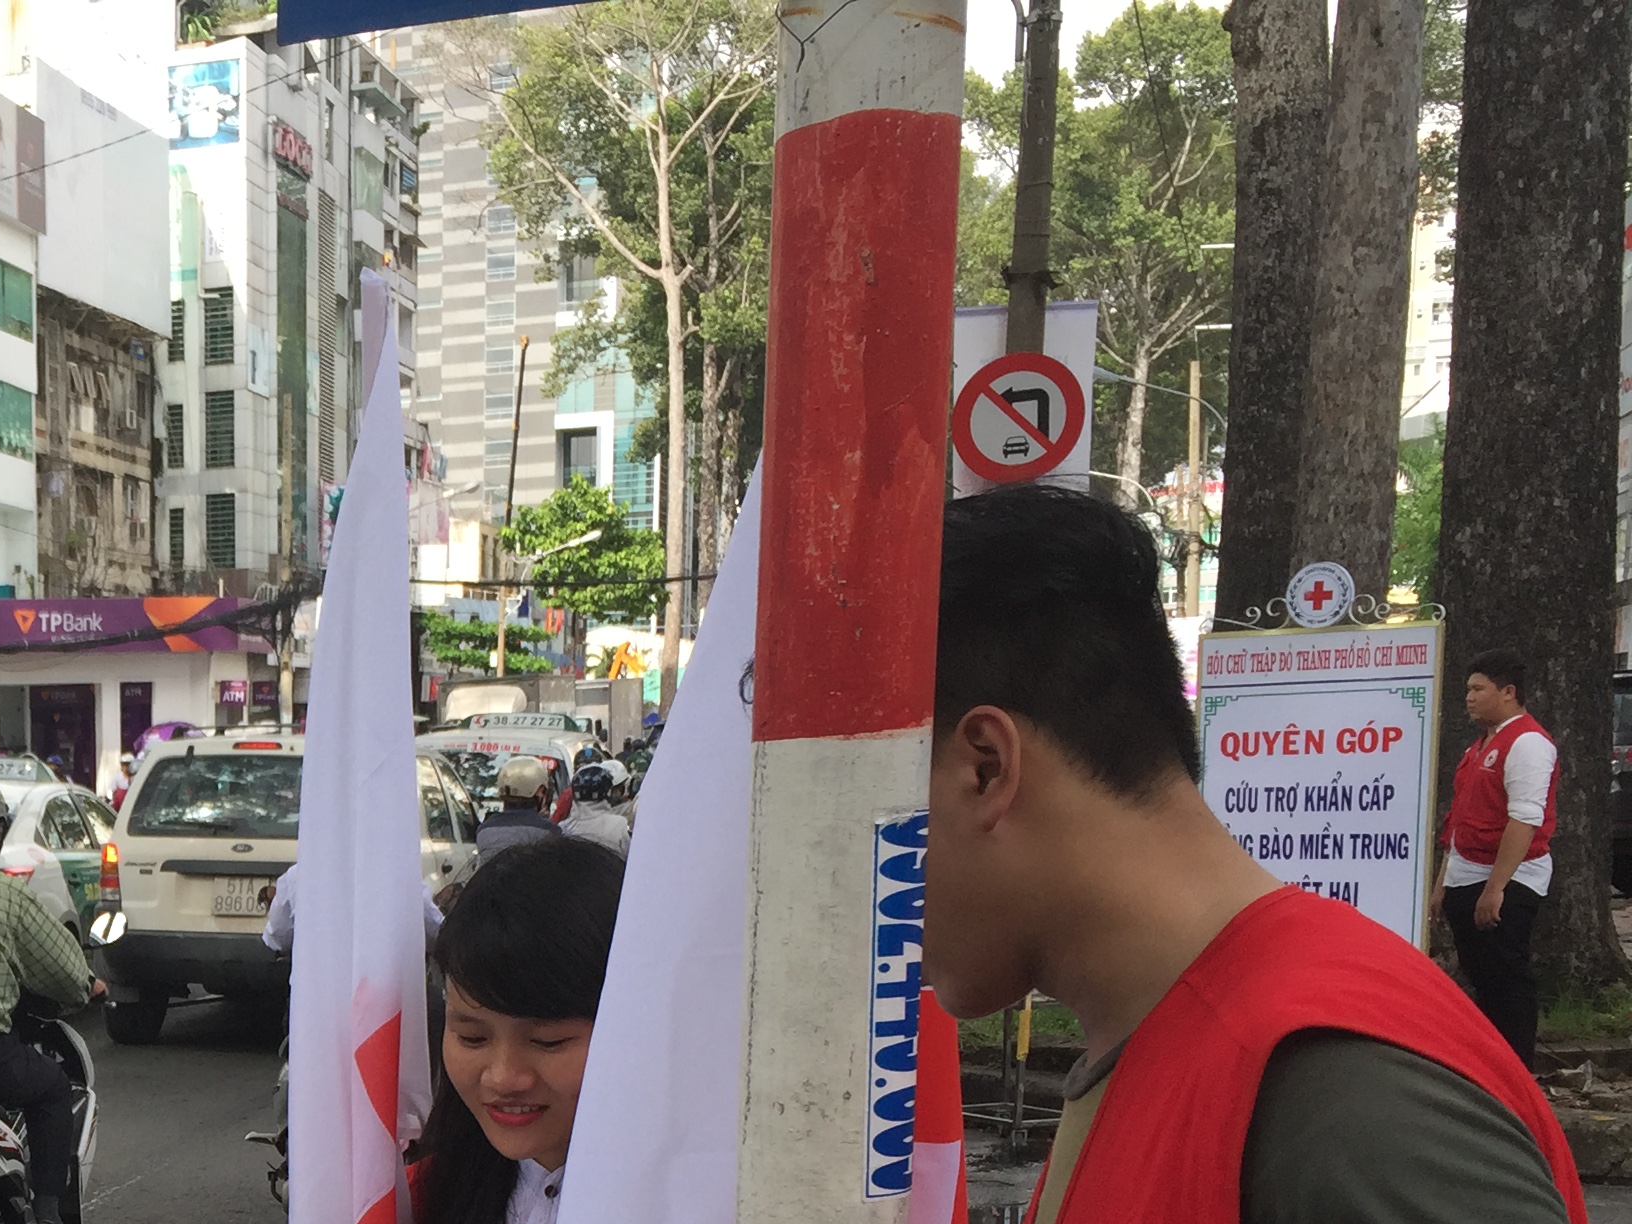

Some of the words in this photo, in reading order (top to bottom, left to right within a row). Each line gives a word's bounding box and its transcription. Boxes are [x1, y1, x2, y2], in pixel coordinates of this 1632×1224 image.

[38, 611, 103, 633] TPBank
[1250, 646, 1277, 677] THẬP
[1296, 643, 1331, 671] THÀNH
[1334, 639, 1356, 669] PHỐ
[1374, 640, 1394, 667] CHÍ
[222, 690, 245, 703] ATM
[530, 717, 544, 726] 27
[548, 718, 562, 726] 27
[1220, 723, 1325, 762] QUYÊN
[1336, 720, 1404, 754] GÓP
[1225, 779, 1259, 814] CỨU
[1264, 782, 1300, 818] TRỢ
[1304, 771, 1354, 813] KHẨN
[1358, 773, 1395, 812] CẤP
[1258, 827, 1294, 860] BÀO
[1299, 822, 1345, 860] MIỀN
[1350, 833, 1410, 860] TRUNG
[226, 877, 255, 896] 51A
